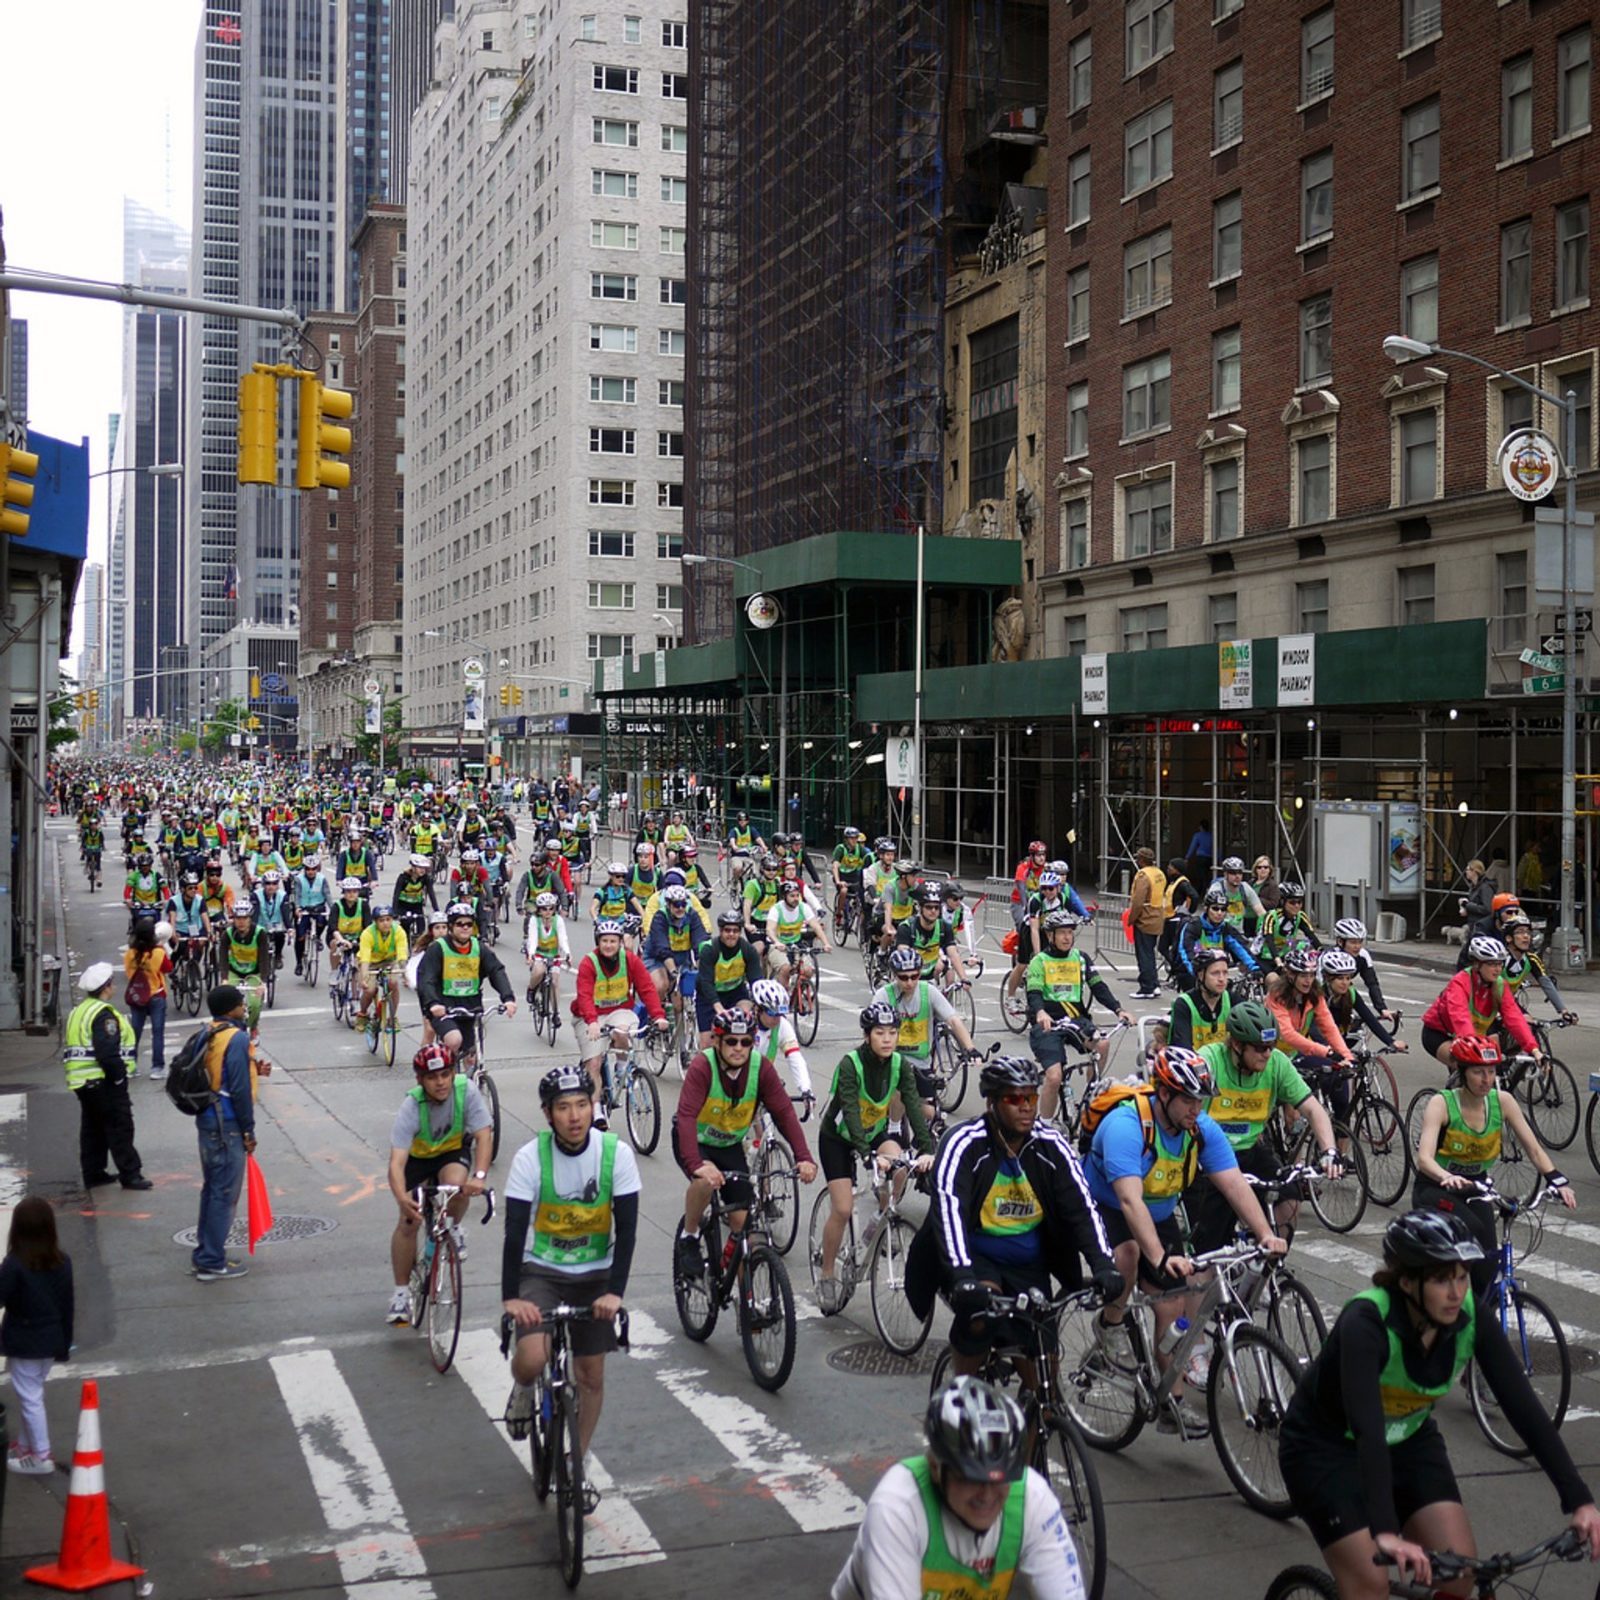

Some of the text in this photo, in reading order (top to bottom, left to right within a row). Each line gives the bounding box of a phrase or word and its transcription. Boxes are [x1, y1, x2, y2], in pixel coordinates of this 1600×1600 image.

[1511, 485, 1549, 498] COSTA RICA
[1547, 640, 1563, 650] ONE
[1222, 644, 1250, 661] SPRING
[1282, 649, 1310, 666] WINDSOR
[1280, 675, 1312, 692] PHARMACY
[1542, 678, 1550, 690] 6
[11, 715, 36, 727] WAY
